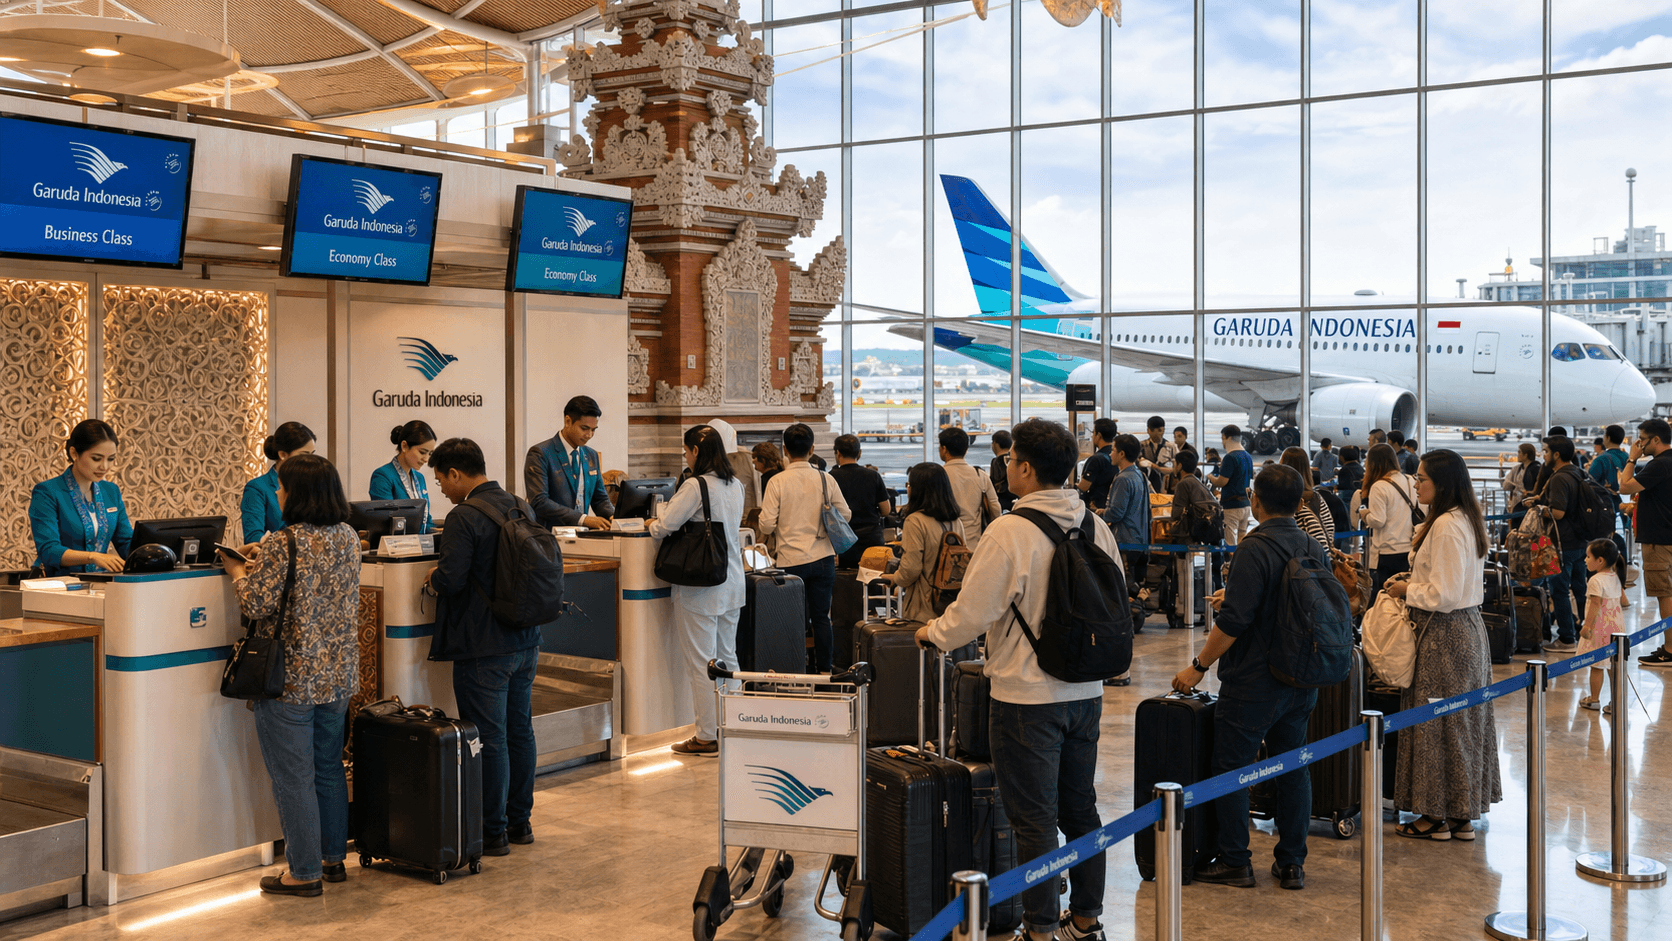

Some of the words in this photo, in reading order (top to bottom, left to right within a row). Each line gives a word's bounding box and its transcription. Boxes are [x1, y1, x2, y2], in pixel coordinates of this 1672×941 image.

[33, 182, 80, 201] Garuda
[84, 187, 142, 207] Indonesia
[323, 214, 358, 230] Garuda
[361, 218, 403, 234] Indonesia
[44, 225, 98, 243] Business
[102, 229, 133, 245] Class
[541, 237, 568, 251] Garuda
[570, 240, 603, 254] Indonesia
[329, 249, 372, 268] Economy
[374, 253, 397, 267] Class
[544, 267, 577, 283] Economy
[579, 270, 597, 282] Class
[1213, 317, 1293, 336] GARUDA
[1310, 317, 1416, 338] NDONESIA
[372, 389, 421, 407] Garuda
[425, 390, 483, 407] Indonesia
[738, 713, 769, 724] Garuda
[770, 715, 812, 726] Indonesia
